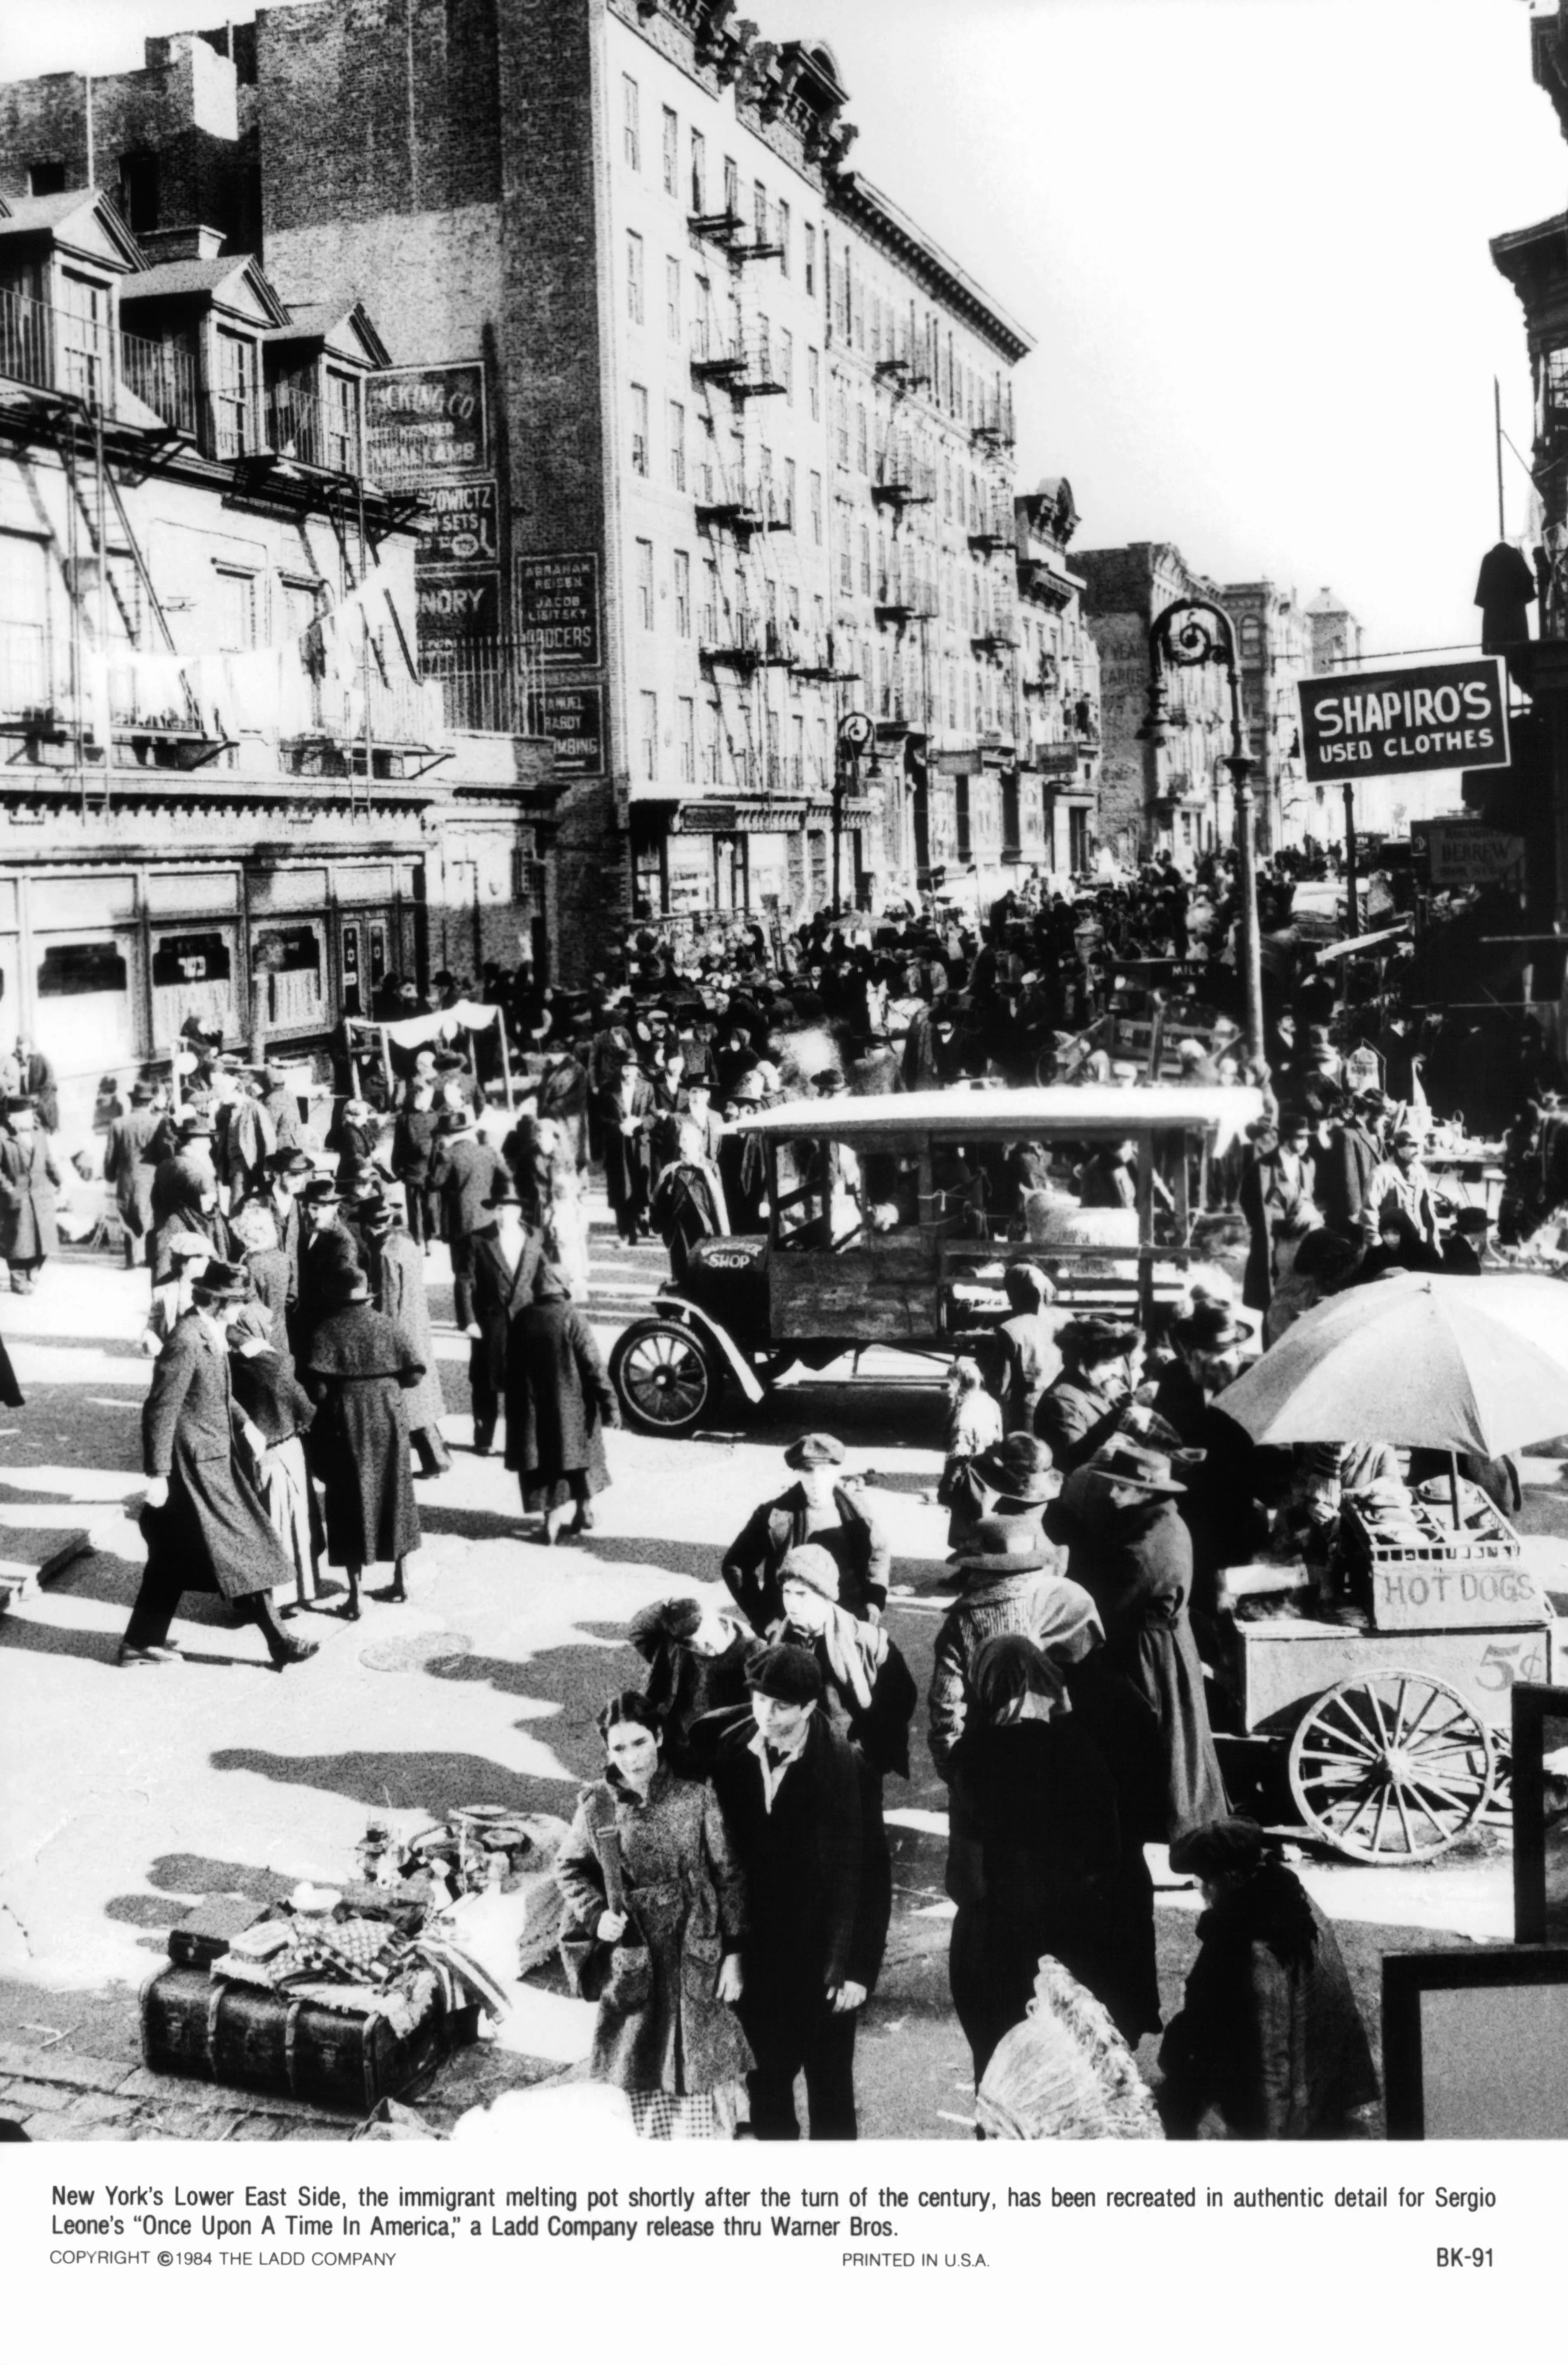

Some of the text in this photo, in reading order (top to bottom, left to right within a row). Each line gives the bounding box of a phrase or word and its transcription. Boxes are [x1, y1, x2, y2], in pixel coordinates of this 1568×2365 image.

[442, 513, 479, 531] SETS
[526, 563, 590, 577] ABRAHAM
[536, 596, 580, 608] JACOB
[1314, 682, 1491, 737] SHAPIRO'S
[1319, 728, 1494, 762] USED CLOTHES
[1171, 964, 1207, 977] MILK
[707, 1254, 750, 1268] SHOP
[1385, 1573, 1535, 1606] HOT DOGS
[1476, 1644, 1542, 1691] 5¢
